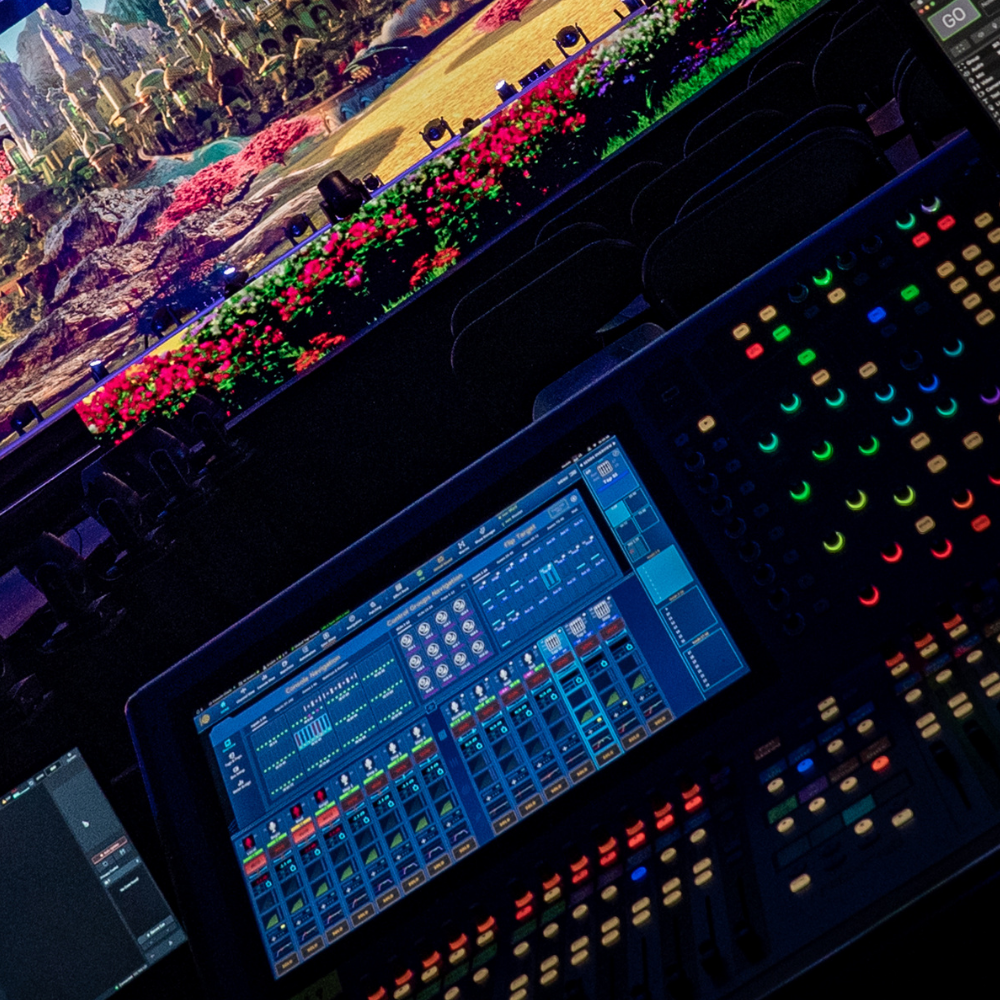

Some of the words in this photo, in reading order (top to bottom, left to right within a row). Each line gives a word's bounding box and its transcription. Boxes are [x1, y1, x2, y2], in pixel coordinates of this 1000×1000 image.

[942, 7, 966, 29] GO
[504, 536, 516, 549] Flip
[516, 523, 537, 541] Target
[387, 609, 409, 626] Control
[410, 594, 431, 612] Groups
[432, 573, 464, 598] Navigation
[286, 676, 309, 695] Console
[310, 654, 341, 679] Navigation
